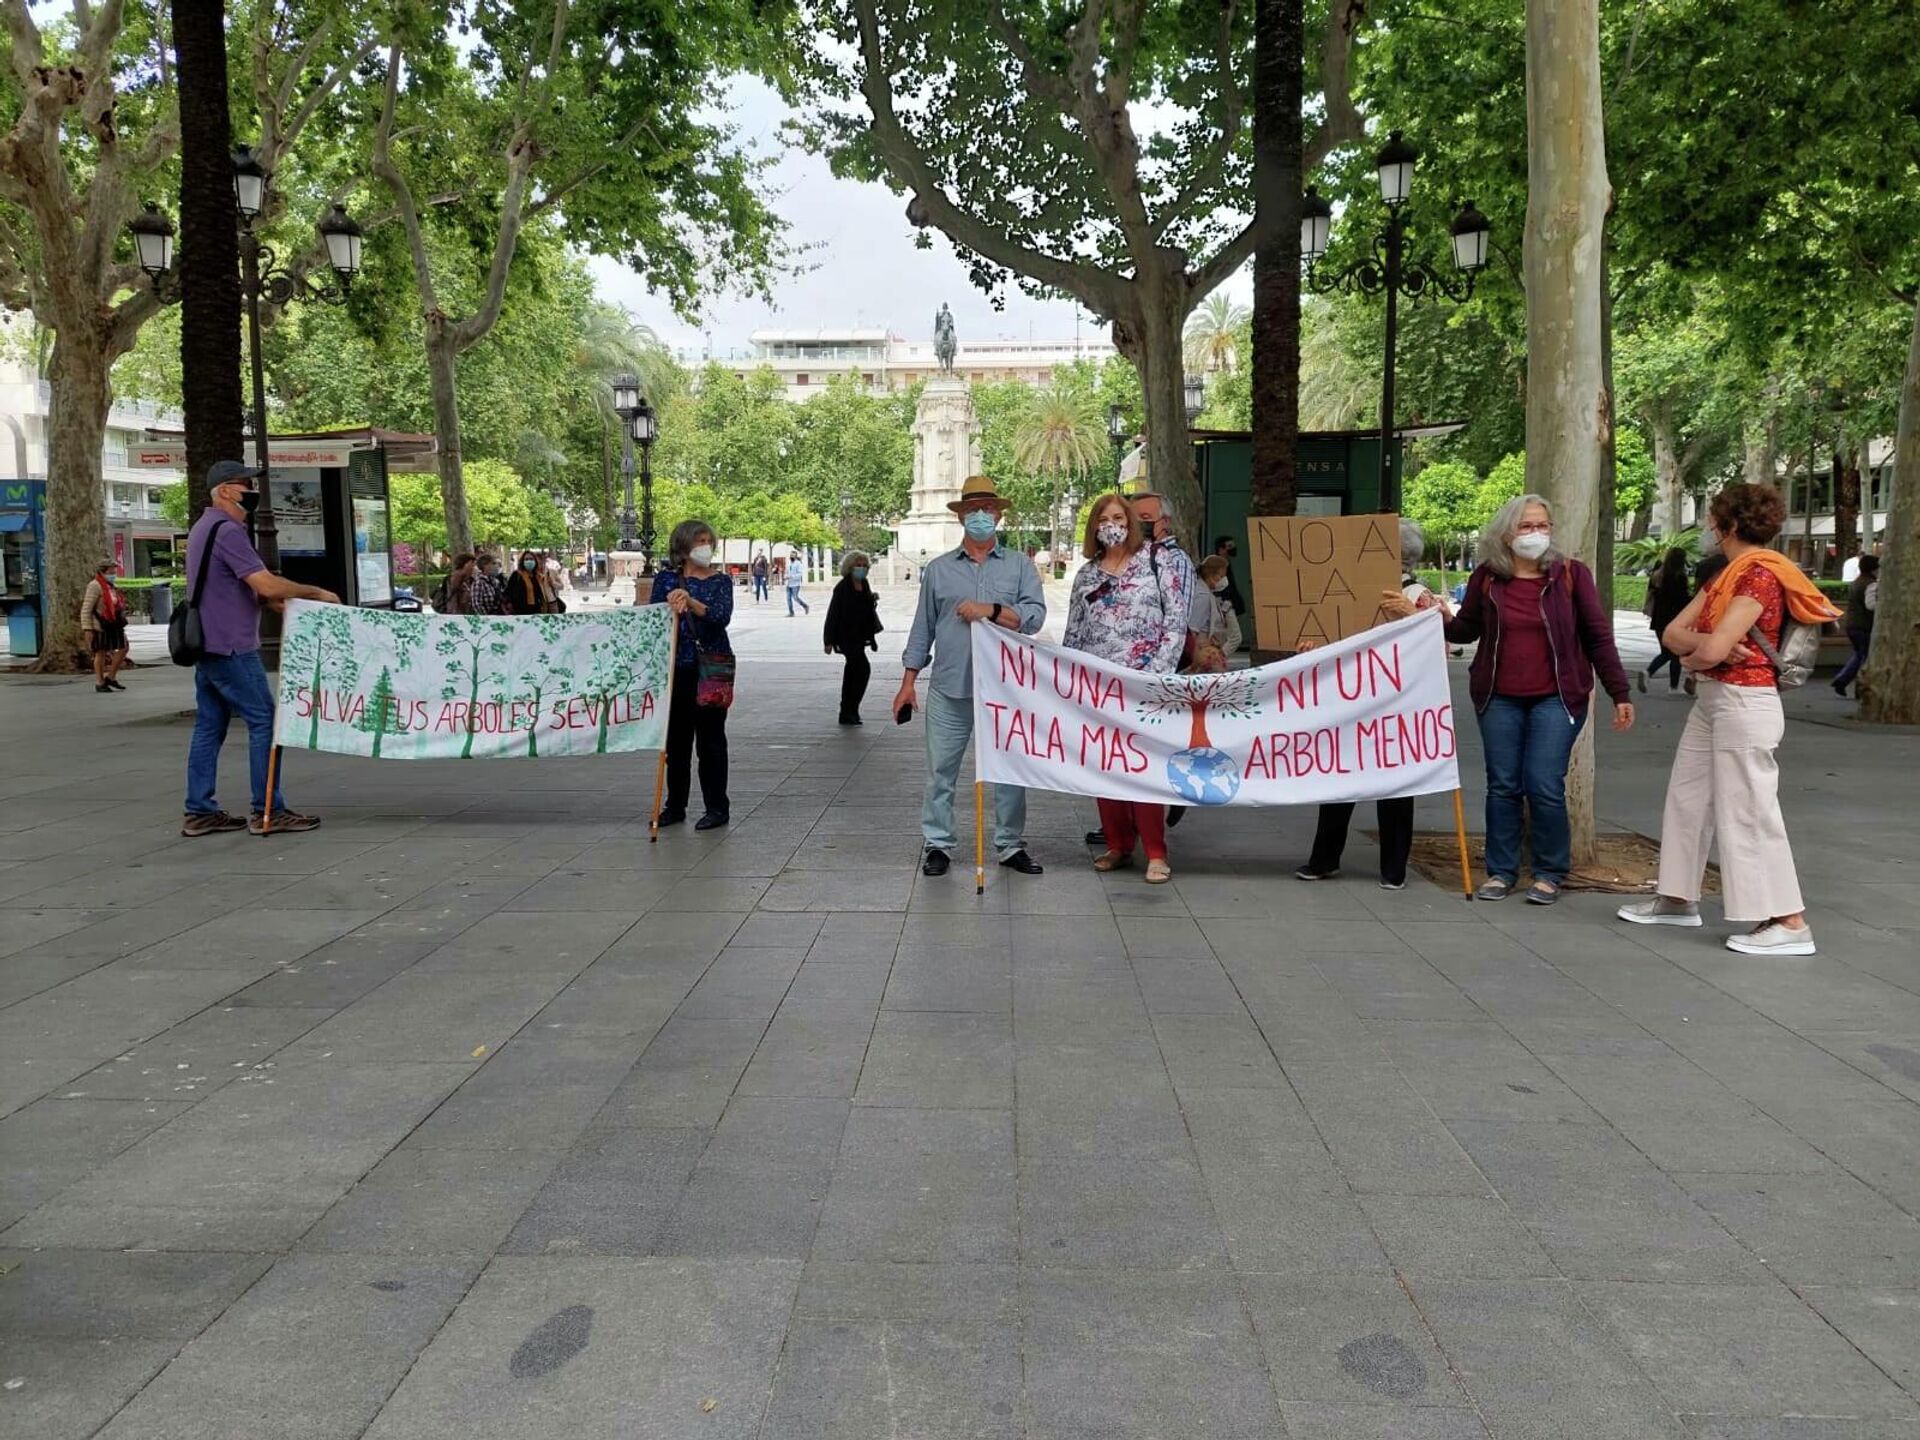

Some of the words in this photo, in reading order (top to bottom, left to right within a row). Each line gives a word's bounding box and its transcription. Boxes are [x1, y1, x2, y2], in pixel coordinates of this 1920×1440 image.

[1258, 519, 1334, 565] NO
[1357, 519, 1396, 563] A
[1296, 567, 1357, 605] LA
[1053, 657, 1124, 712] UNA
[1336, 643, 1401, 700] UN
[296, 687, 366, 728] SALVA
[379, 694, 429, 731] TUS
[435, 699, 540, 734] ARBOLES
[549, 690, 655, 731] SEVILLA
[985, 702, 1065, 763] TALA
[1080, 723, 1149, 773] MAS
[1244, 727, 1351, 780] ARBOL
[1357, 704, 1456, 771] MENOS
